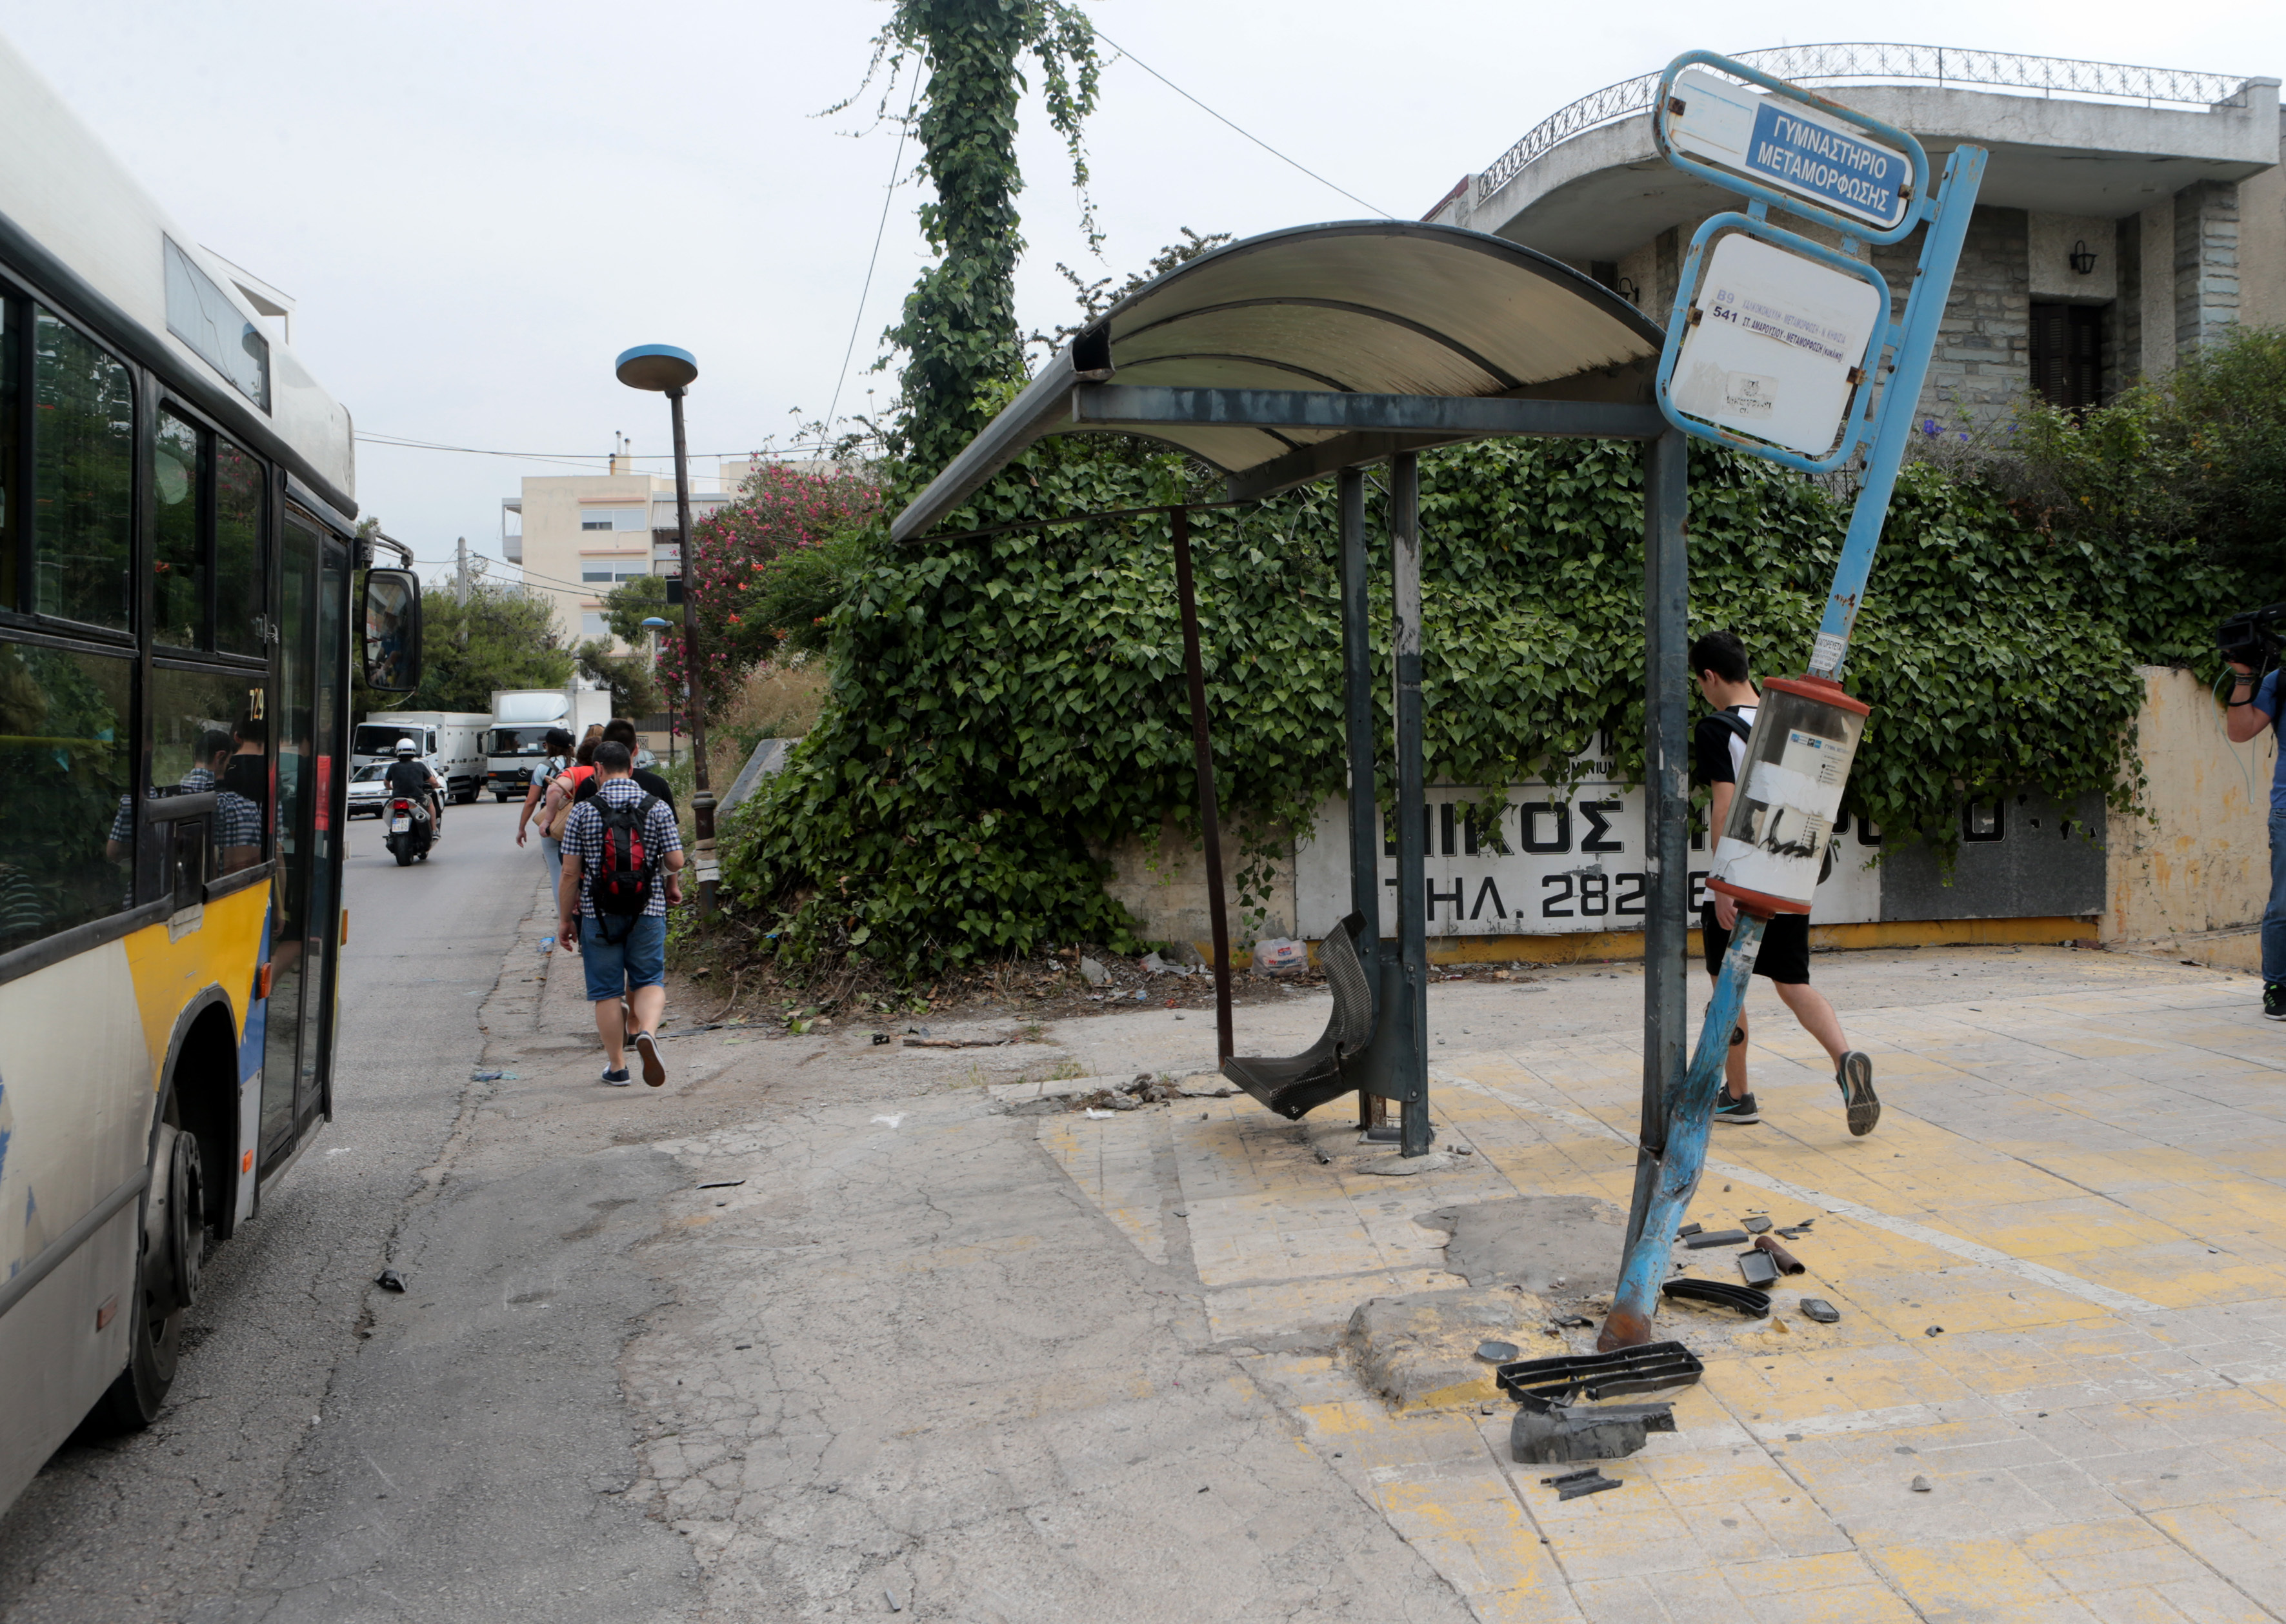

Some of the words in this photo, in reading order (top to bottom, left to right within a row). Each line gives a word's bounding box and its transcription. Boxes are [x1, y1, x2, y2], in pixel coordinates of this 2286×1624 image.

[1773, 115, 1887, 179] ΓΥΜΝΑΣΤΗΡΙΟ
[1758, 141, 1890, 213] ΜΕΤΑΜΟΡΦΩΣΗΣ
[1712, 306, 1738, 323] 541
[1742, 317, 1750, 328] ΣΤ.
[1751, 320, 1784, 339] ΑΜΑΡΟΥΣΙΟΥ
[1786, 332, 1824, 354] ΜΕΤΑΜΟΡΦΩΣΗ
[249, 688, 264, 721] 729
[1385, 876, 1524, 921] ΗΛ.
